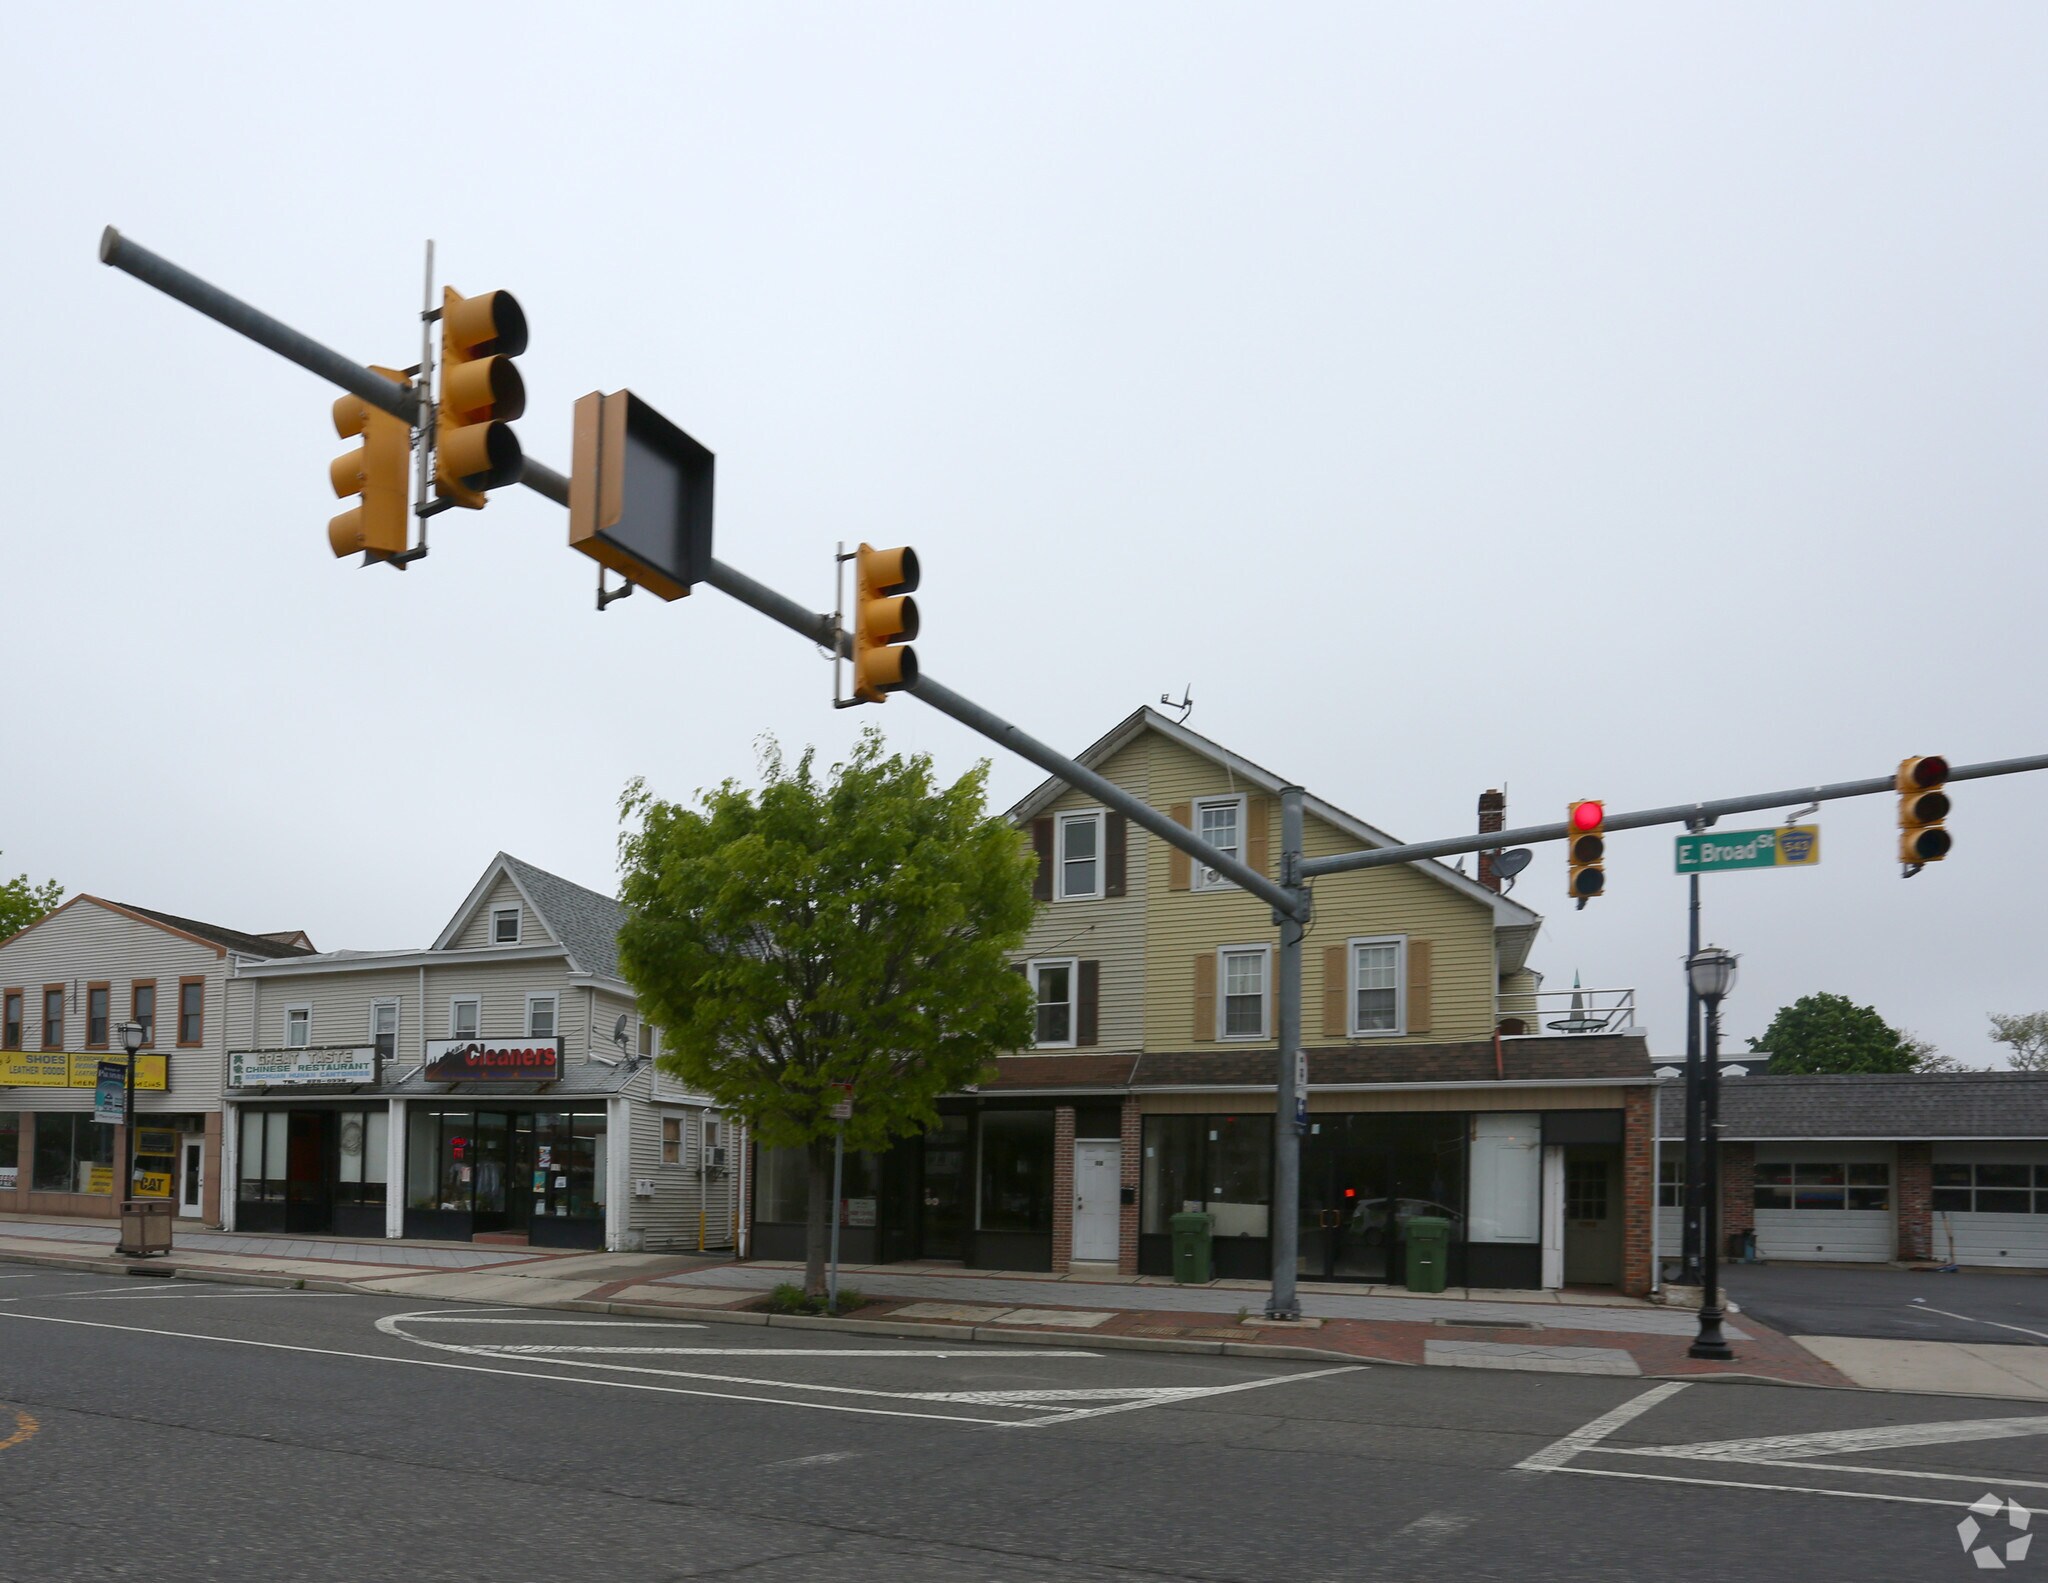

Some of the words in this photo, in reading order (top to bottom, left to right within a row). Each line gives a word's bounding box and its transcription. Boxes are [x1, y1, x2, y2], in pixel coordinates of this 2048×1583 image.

[1679, 845, 1698, 864] E.
[1701, 840, 1756, 863] Broad
[1757, 834, 1776, 849] St
[26, 1055, 65, 1065] SHOES
[257, 1052, 299, 1066] GREAT
[308, 1050, 353, 1064] TASTE
[465, 1043, 556, 1067] Cleaners
[10, 1066, 39, 1075] LEATHER
[43, 1067, 65, 1076] GOODS
[246, 1065, 291, 1074] CHINESE
[298, 1063, 370, 1072] RESTAURANT
[141, 1177, 164, 1191] CAT
